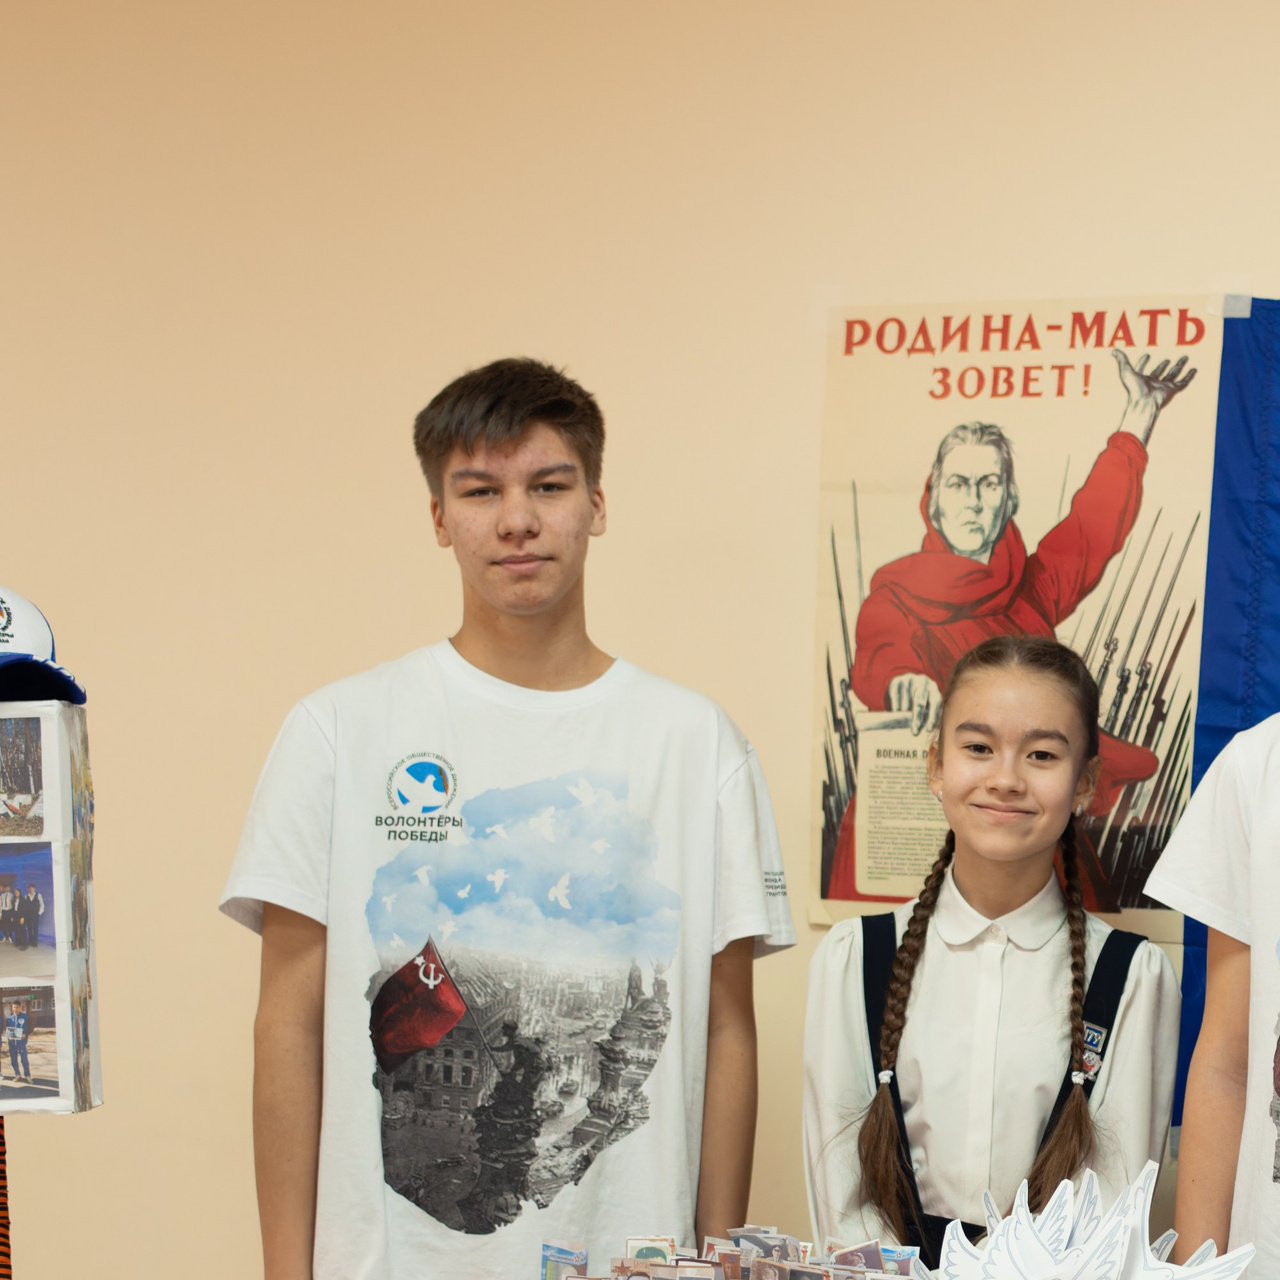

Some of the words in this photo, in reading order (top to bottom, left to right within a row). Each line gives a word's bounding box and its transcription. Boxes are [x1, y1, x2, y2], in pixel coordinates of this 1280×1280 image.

[843, 308, 1206, 357] РОДИНА-МАТЬ
[928, 364, 1092, 400] ЗОВЕТ!
[876, 748, 918, 759] ВОЕННАЯ
[375, 815, 463, 828] ВОЛОНТЁРЫ
[387, 830, 448, 843] ПОБЕДЫ
